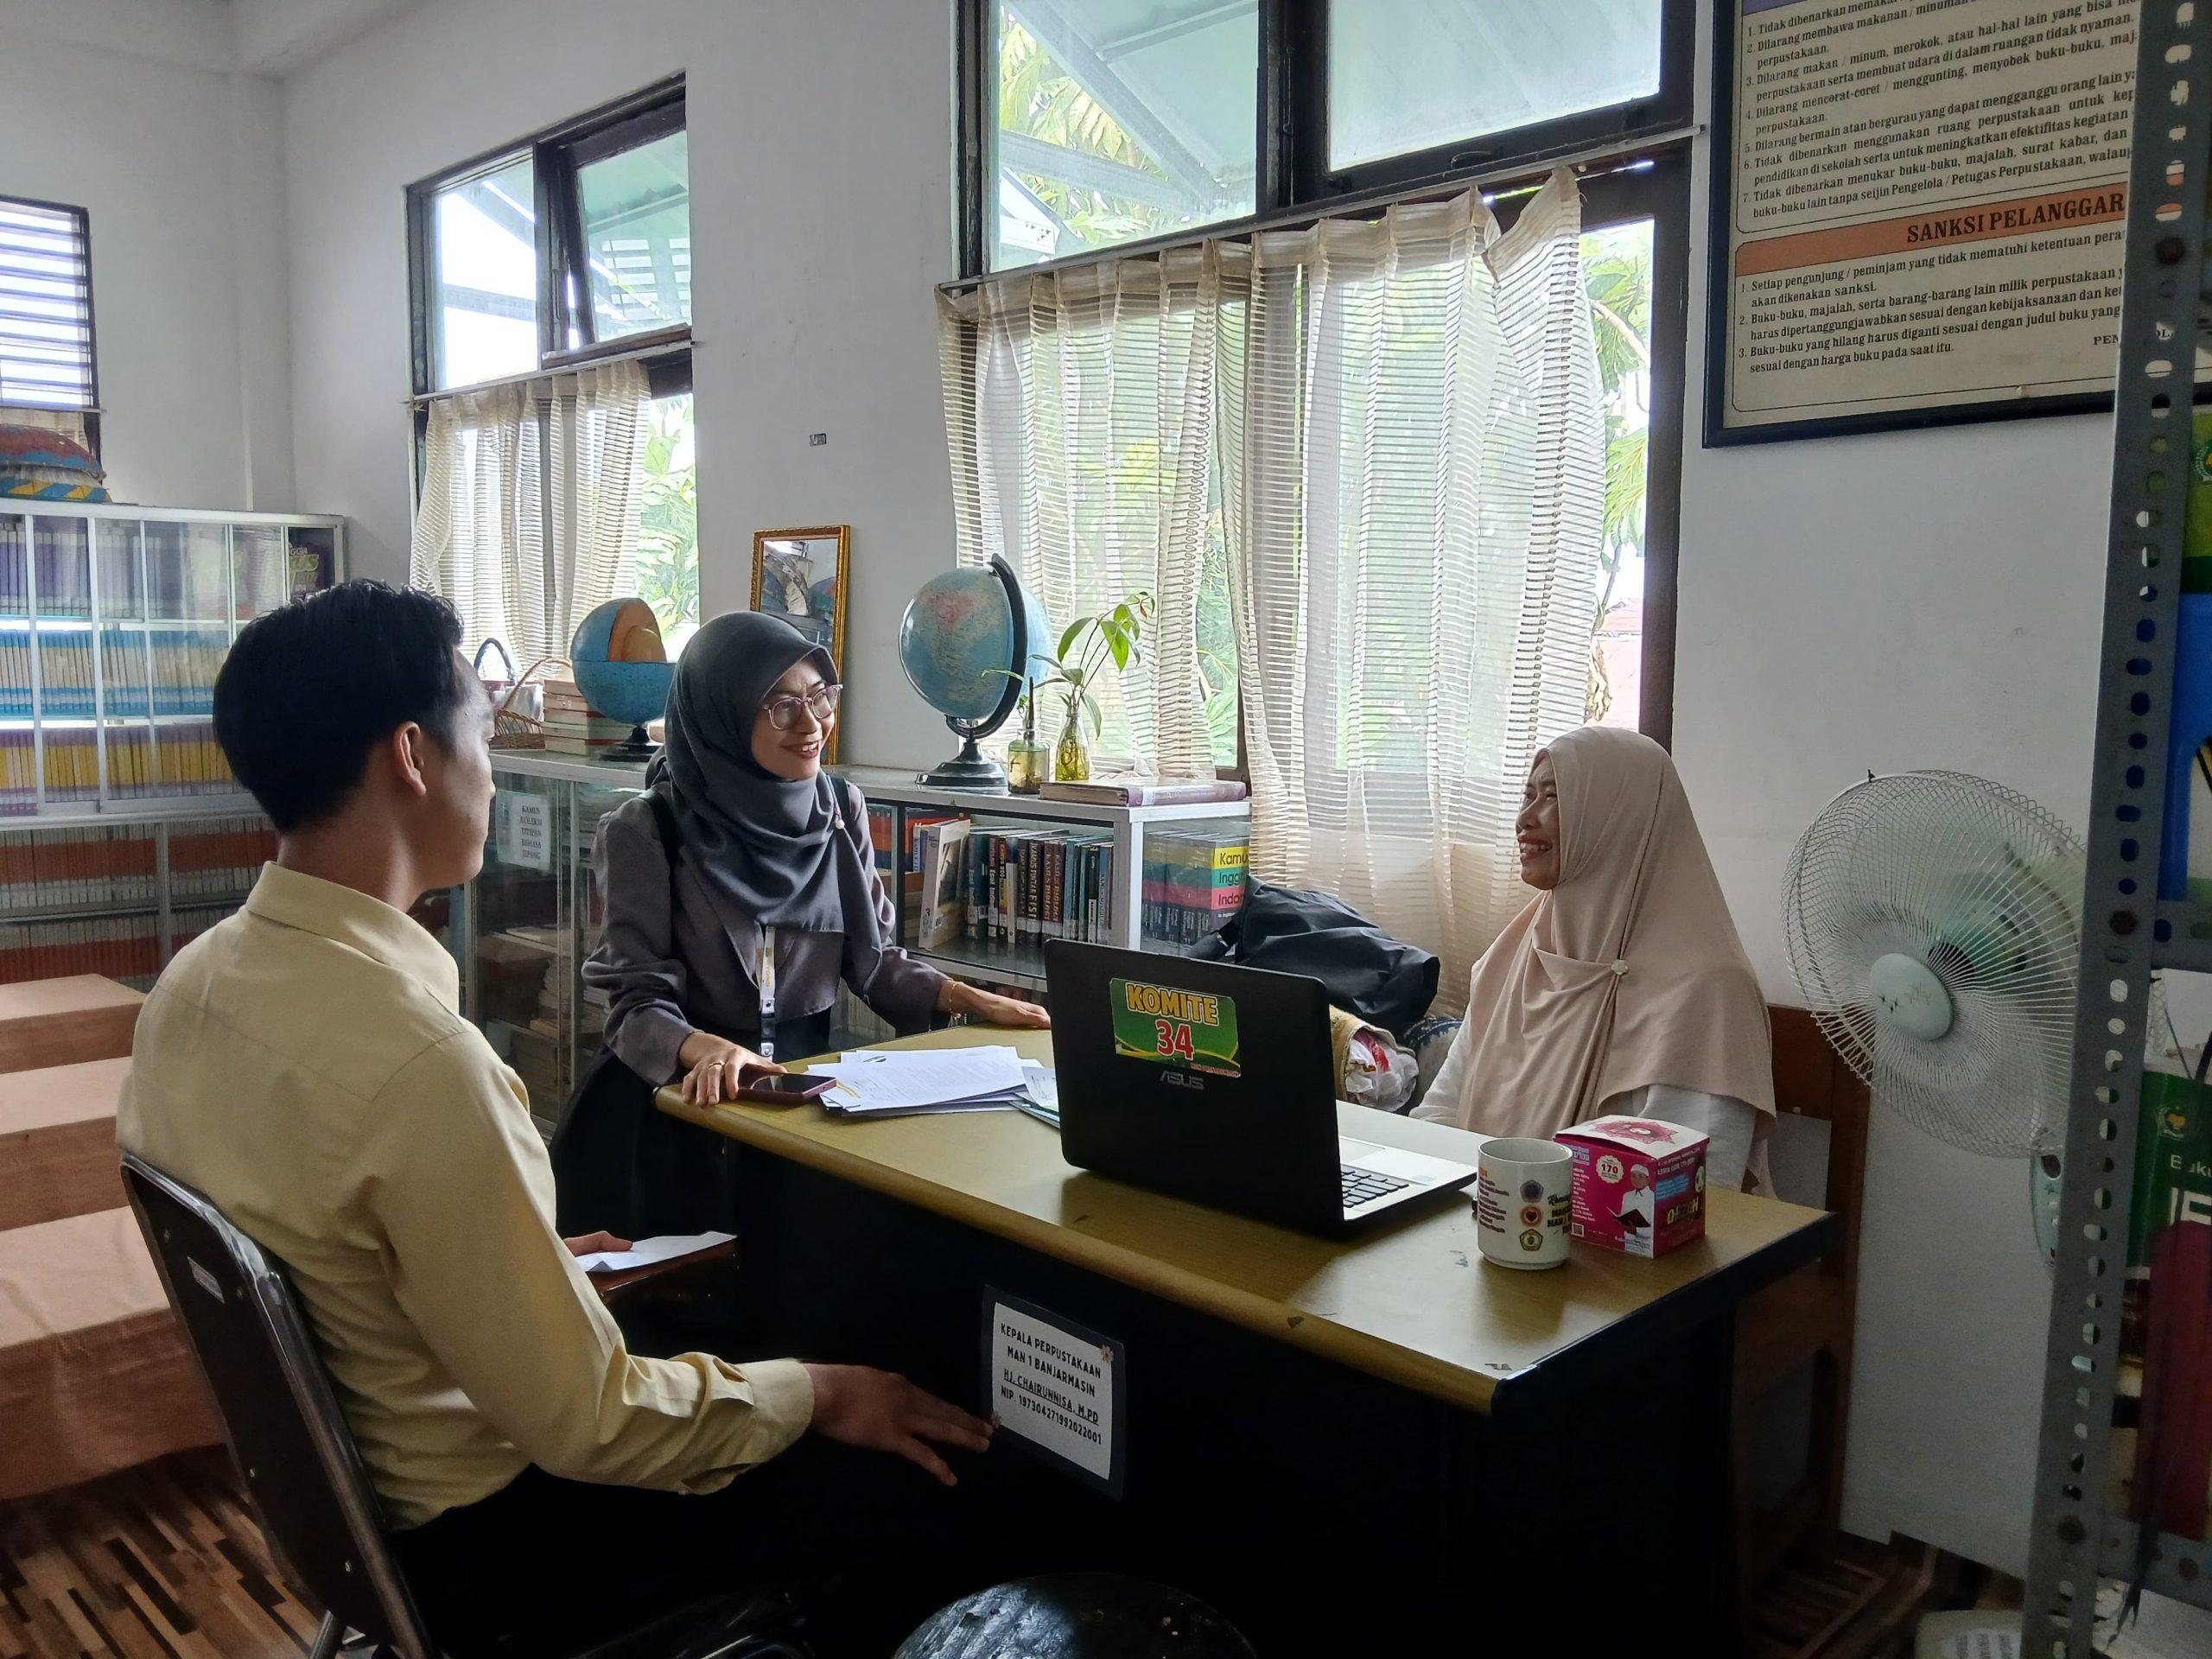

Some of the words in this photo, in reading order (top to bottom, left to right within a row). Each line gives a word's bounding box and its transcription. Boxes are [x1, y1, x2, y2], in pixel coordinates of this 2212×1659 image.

[1757, 67, 1800, 85] Dilarang
[1802, 59, 1838, 74] makan
[1947, 29, 1974, 43] atau
[1978, 16, 2019, 36] hal-hal
[2024, 12, 2047, 27] lain
[2050, 5, 2082, 23] yang
[2086, 0, 2113, 13] bisa
[1758, 18, 1786, 35] Tidak
[1788, 7, 1846, 28] dibenarkan
[1758, 35, 1800, 52] Dilarang
[1802, 22, 1854, 41] membawa
[1856, 10, 1907, 29] makanan
[1756, 79, 1826, 104] perpustakaan
[1827, 72, 1854, 86] serta
[1856, 60, 1906, 79] membuat
[1907, 54, 1941, 69] udara
[1942, 49, 1953, 62] di
[1955, 44, 1991, 60] dalam
[1993, 33, 2044, 52] ruangan
[2045, 22, 2077, 41] tidak
[1756, 102, 1798, 118] Dilarang
[1802, 84, 1879, 109] mencorat-coret
[1972, 53, 2031, 75] menyobek
[2109, 31, 2138, 48] maj
[1754, 153, 1783, 168] Tidak
[1789, 143, 1847, 162] dibenarkan
[1853, 128, 1930, 150] menggunakan
[1936, 120, 1970, 135] ruang
[1978, 104, 2060, 130] perpustakaan
[2069, 92, 2105, 110] untuk
[1755, 136, 1797, 151] Dilarang
[1798, 125, 1840, 143] bermain
[1842, 122, 1866, 134] atau
[1868, 111, 1916, 130] bergurau
[1918, 106, 1946, 123] yang
[1947, 98, 1980, 114] dapat
[1981, 84, 2058, 107] mengganggu
[2060, 77, 2096, 92] orang
[2098, 70, 2122, 85] lain
[1753, 186, 1782, 201] Tidak
[1785, 178, 1843, 196] dibenarkan
[1847, 168, 1896, 186] menukar
[2021, 141, 2054, 156] surat
[2103, 130, 2127, 142] dan
[1754, 167, 1808, 188] pendidikan
[1810, 162, 1820, 175] di
[1821, 156, 1861, 173] sekolah
[1862, 152, 1891, 166] serta
[1892, 144, 1923, 161] untuk
[1925, 131, 2008, 155] meningkatkan
[2009, 121, 2071, 140] efektifitas
[2073, 111, 2128, 129] kegiatan
[1752, 200, 1806, 218] buku-buku
[1807, 196, 1827, 209] lain
[1828, 193, 1859, 206] tanpa
[1860, 186, 1889, 200] seijin
[1891, 177, 1943, 195] Pengelola
[1951, 170, 1997, 186] Petugas
[1907, 216, 1984, 243] SANKSI
[1751, 278, 1783, 292] Setiap
[1784, 270, 1845, 290] pengunjung
[1853, 262, 1906, 281] peminjam
[1908, 257, 1936, 273] yang
[1937, 251, 1967, 265] tidak
[1969, 242, 2027, 261] mematuhi
[2030, 236, 2091, 252] ketentuan
[2094, 231, 2125, 246] pera
[1751, 295, 1777, 307] akan
[1777, 288, 1831, 304] dikenakan
[1751, 329, 1779, 340] harus
[1780, 312, 1907, 339] dipertanggungjawabkan
[1908, 306, 1944, 321] sesuai
[1946, 303, 1987, 317] dengan
[1988, 293, 2077, 312] kebijaksanaan
[2079, 289, 2101, 301] dan
[1858, 298, 1885, 310] serta
[1889, 288, 1971, 307] barang-barang
[1974, 283, 1996, 296] lain
[1999, 278, 2028, 293] milik
[2031, 270, 2115, 292] perpustakaan
[1750, 341, 1803, 357] Buku-buku
[1804, 340, 1830, 353] yang
[1832, 335, 1865, 347] hilang
[1866, 332, 1899, 344] harus
[1901, 324, 1940, 341] diganti
[1942, 320, 1979, 335] sesuai
[1980, 317, 2023, 331] dengan
[2024, 311, 2056, 328] judul
[2058, 308, 2088, 321] buku
[2090, 306, 2120, 321] yang
[1750, 359, 1782, 372] sesuai
[1783, 357, 1820, 371] dengan
[1821, 353, 1852, 366] harga
[1853, 349, 1880, 362] buku
[1881, 346, 1908, 362] pada
[1910, 343, 1934, 356] saat
[1125, 982, 1219, 1027] KOMITE
[1155, 1019, 1195, 1061] 34
[1160, 1071, 1204, 1090] ASUS
[1601, 1163, 1618, 1174] 170
[1001, 1323, 1032, 1348] KEPALA
[1034, 1338, 1101, 1379] PERPUSTAKAAN
[1007, 1346, 1026, 1363] MAN
[1028, 1355, 1033, 1366] 1
[1034, 1358, 1096, 1397] BANJARMASIN
[1001, 1385, 1016, 1402] NIP.
[1019, 1395, 1102, 1446] 197304271992022001
[1003, 1369, 1017, 1382] HJ.
[1077, 1404, 1099, 1423] M.PD
